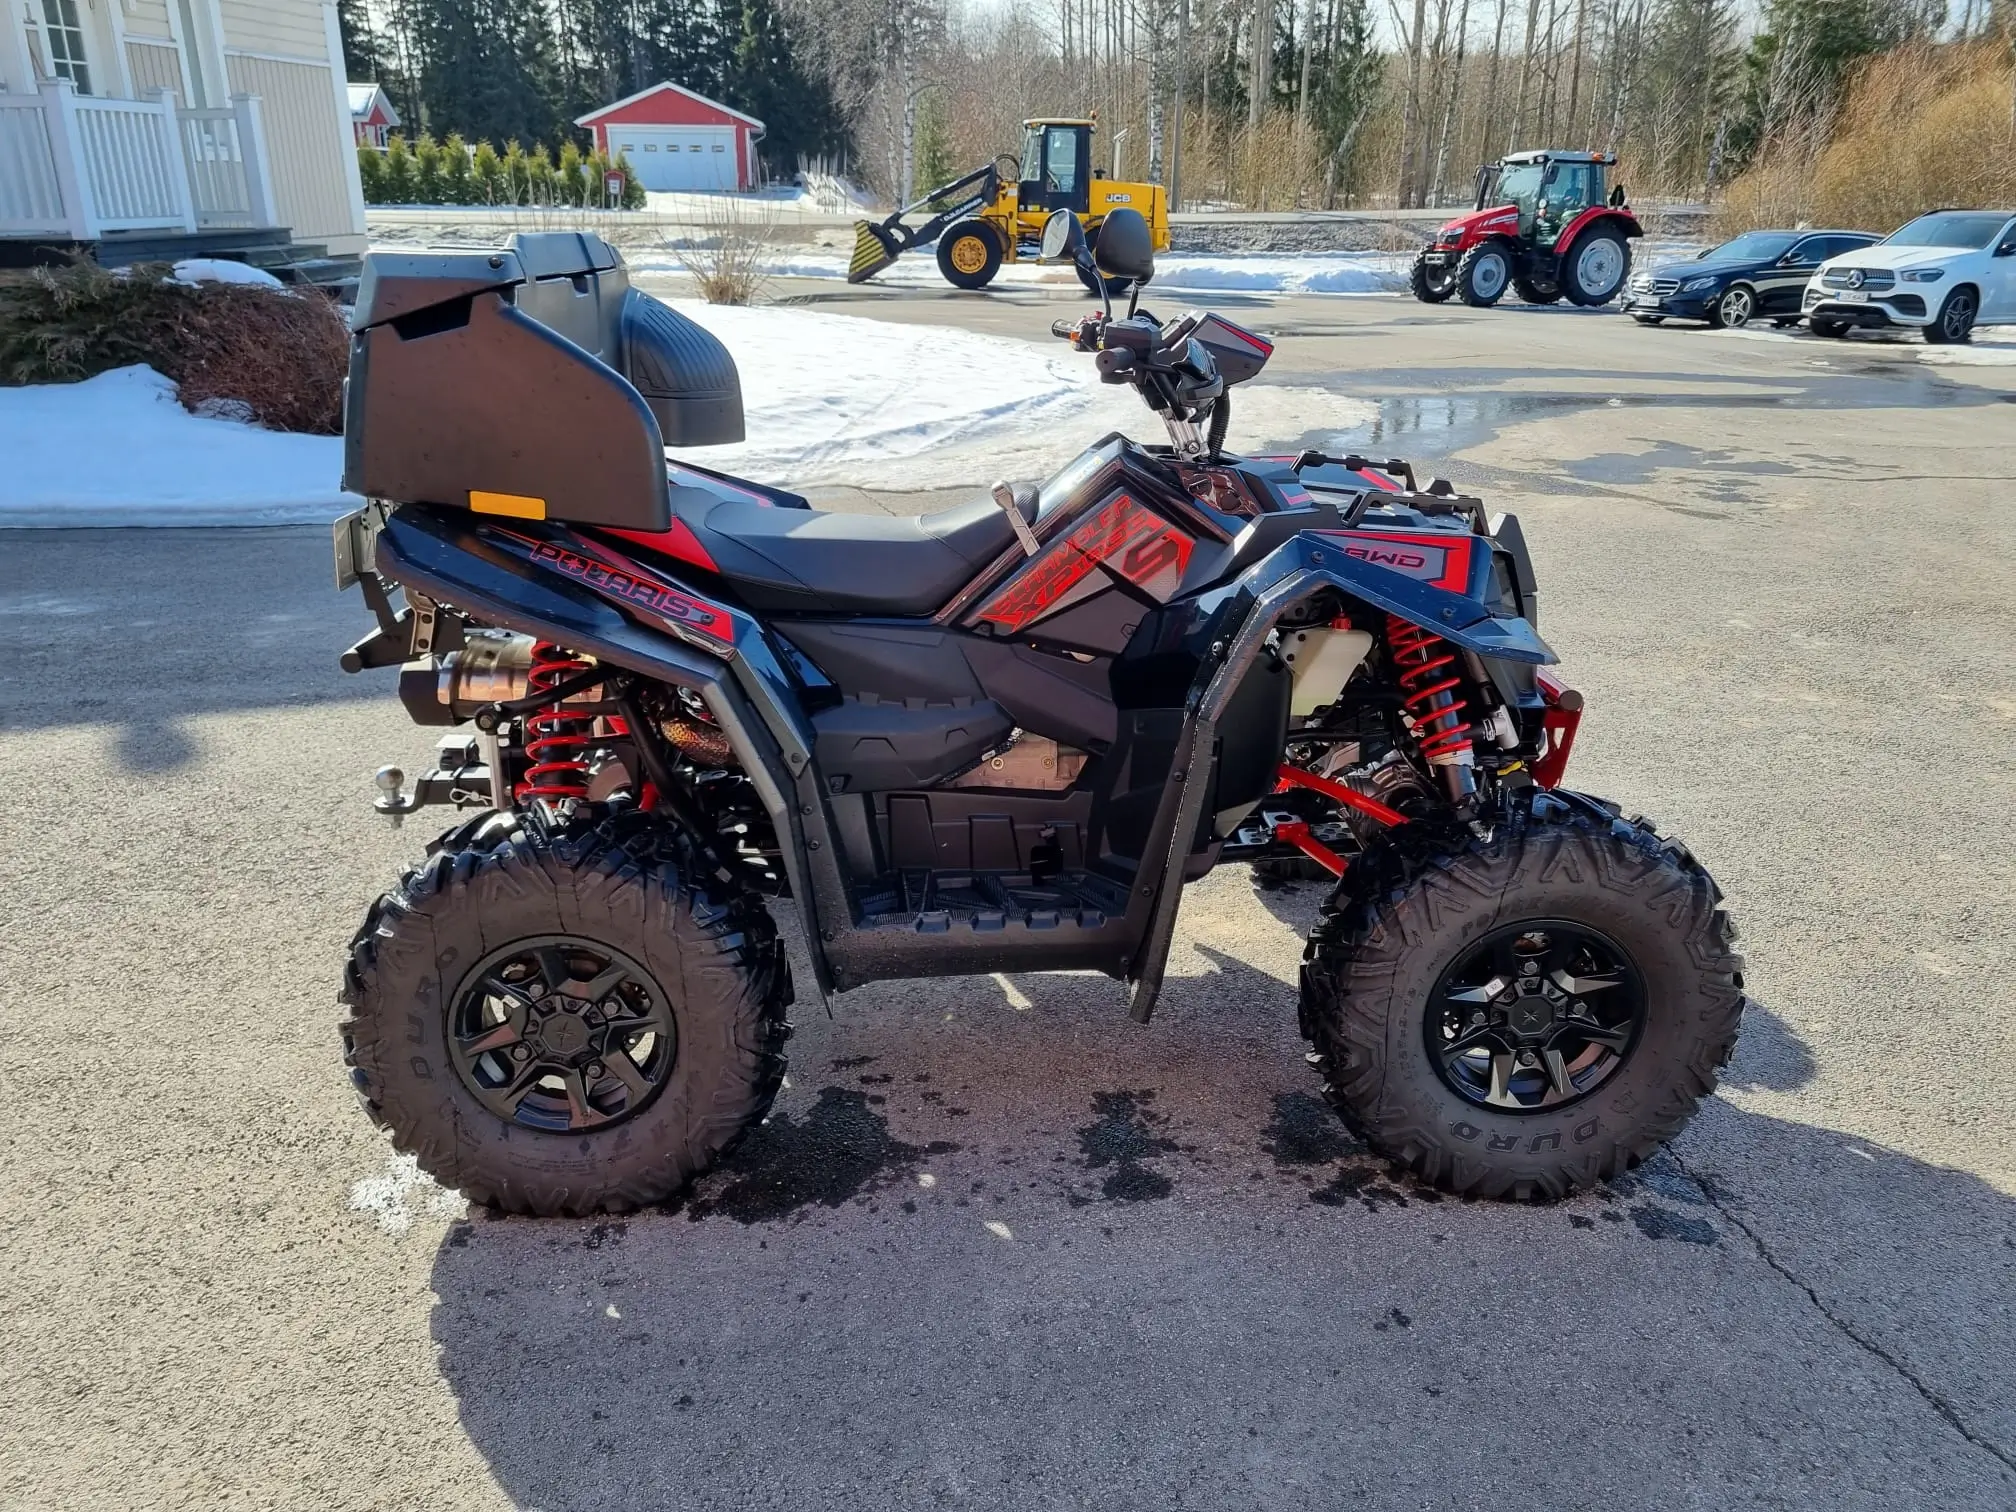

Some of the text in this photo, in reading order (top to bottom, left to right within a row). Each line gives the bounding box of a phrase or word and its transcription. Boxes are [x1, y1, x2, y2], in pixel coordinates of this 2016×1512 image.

[1106, 193, 1131, 203] JCB
[529, 541, 693, 618] POLARIS
[1450, 1116, 1601, 1154] DURO
